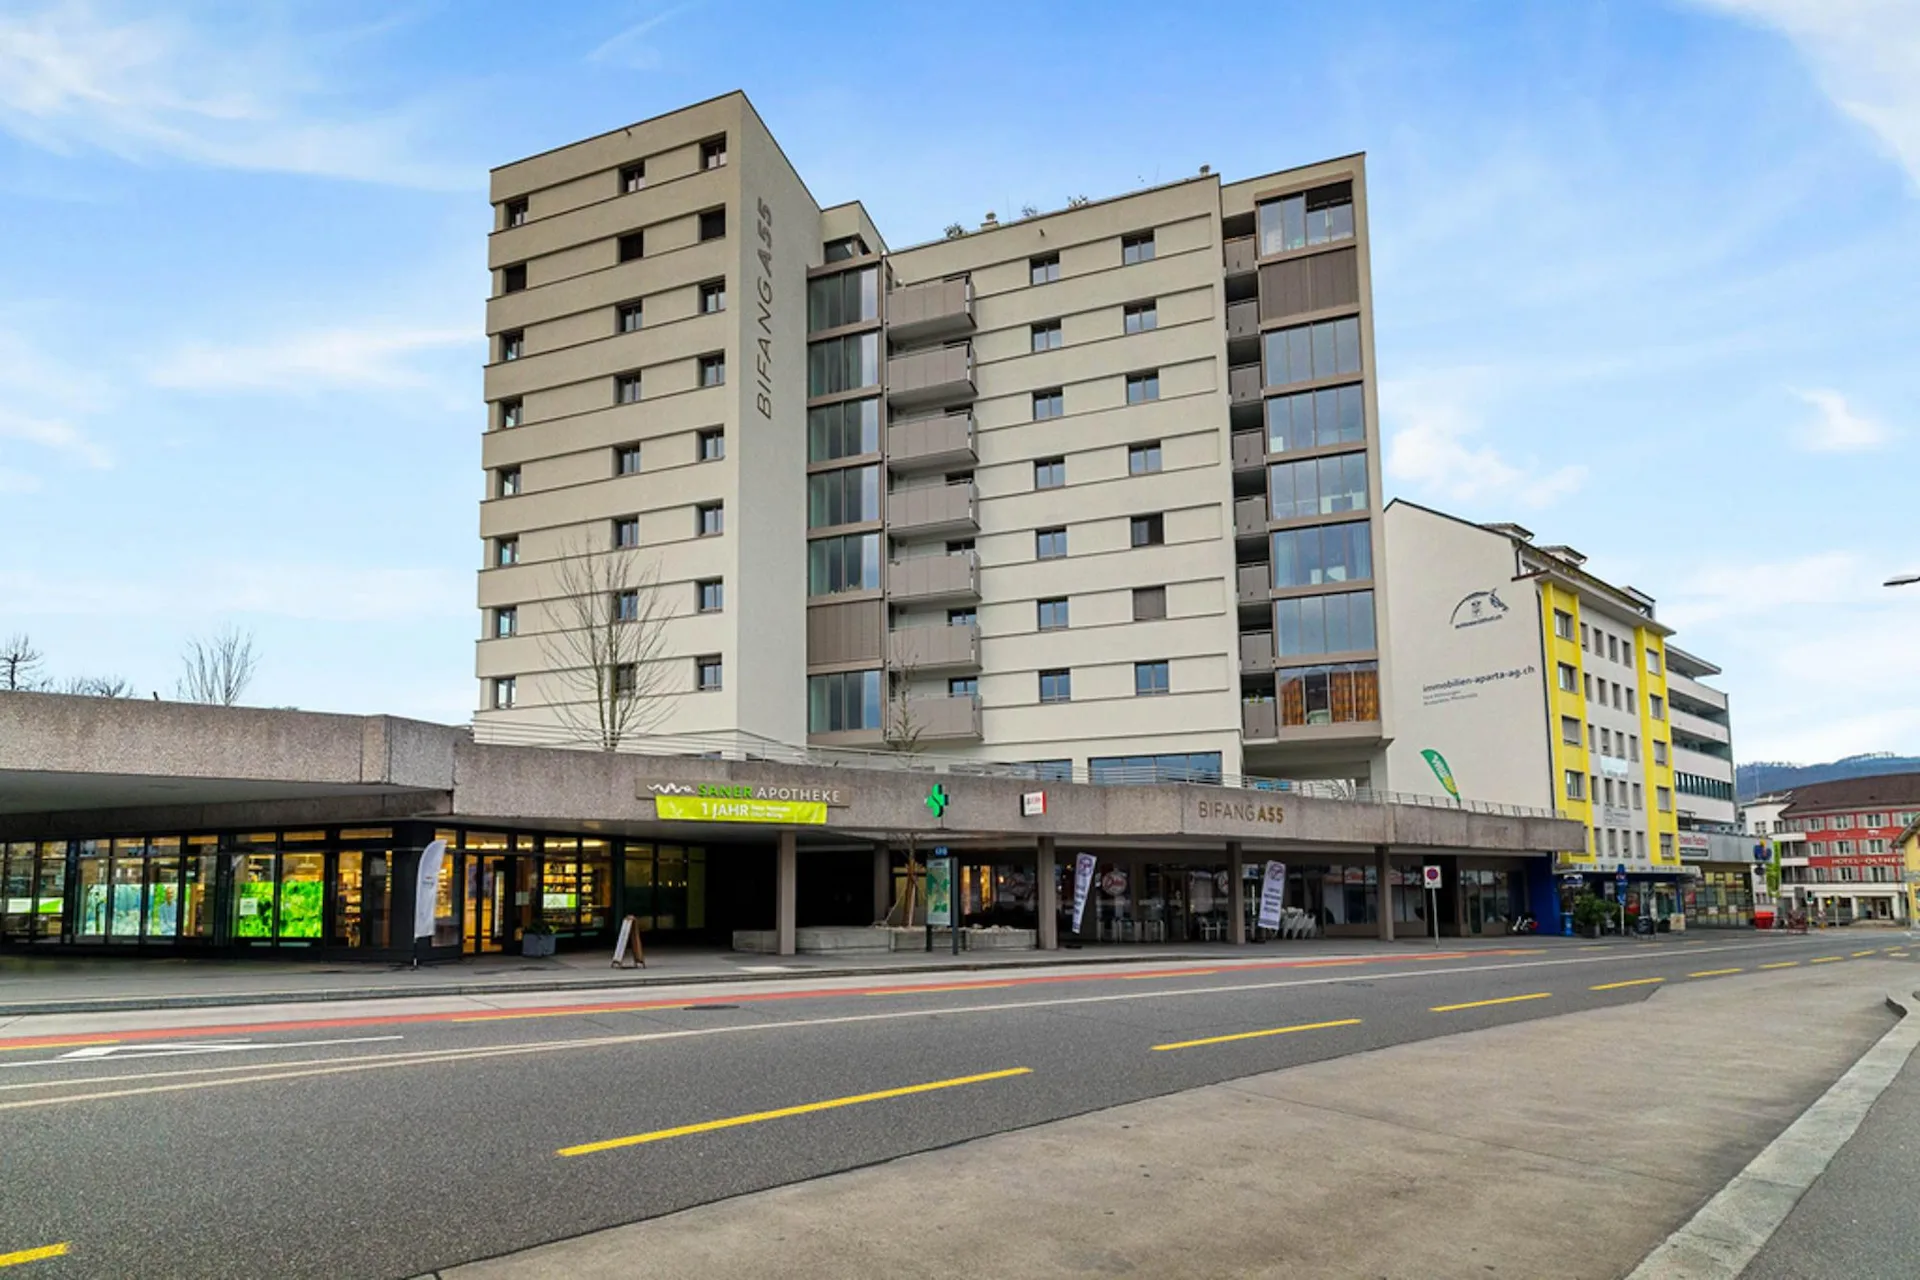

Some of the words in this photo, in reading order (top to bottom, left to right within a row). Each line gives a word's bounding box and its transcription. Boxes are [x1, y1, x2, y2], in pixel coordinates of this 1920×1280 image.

[697, 783, 752, 799] SANER
[757, 787, 840, 802] APOTHEKE
[702, 803, 708, 815] 1
[712, 803, 749, 819] JAHR
[1831, 857, 1859, 865] HOTEL
